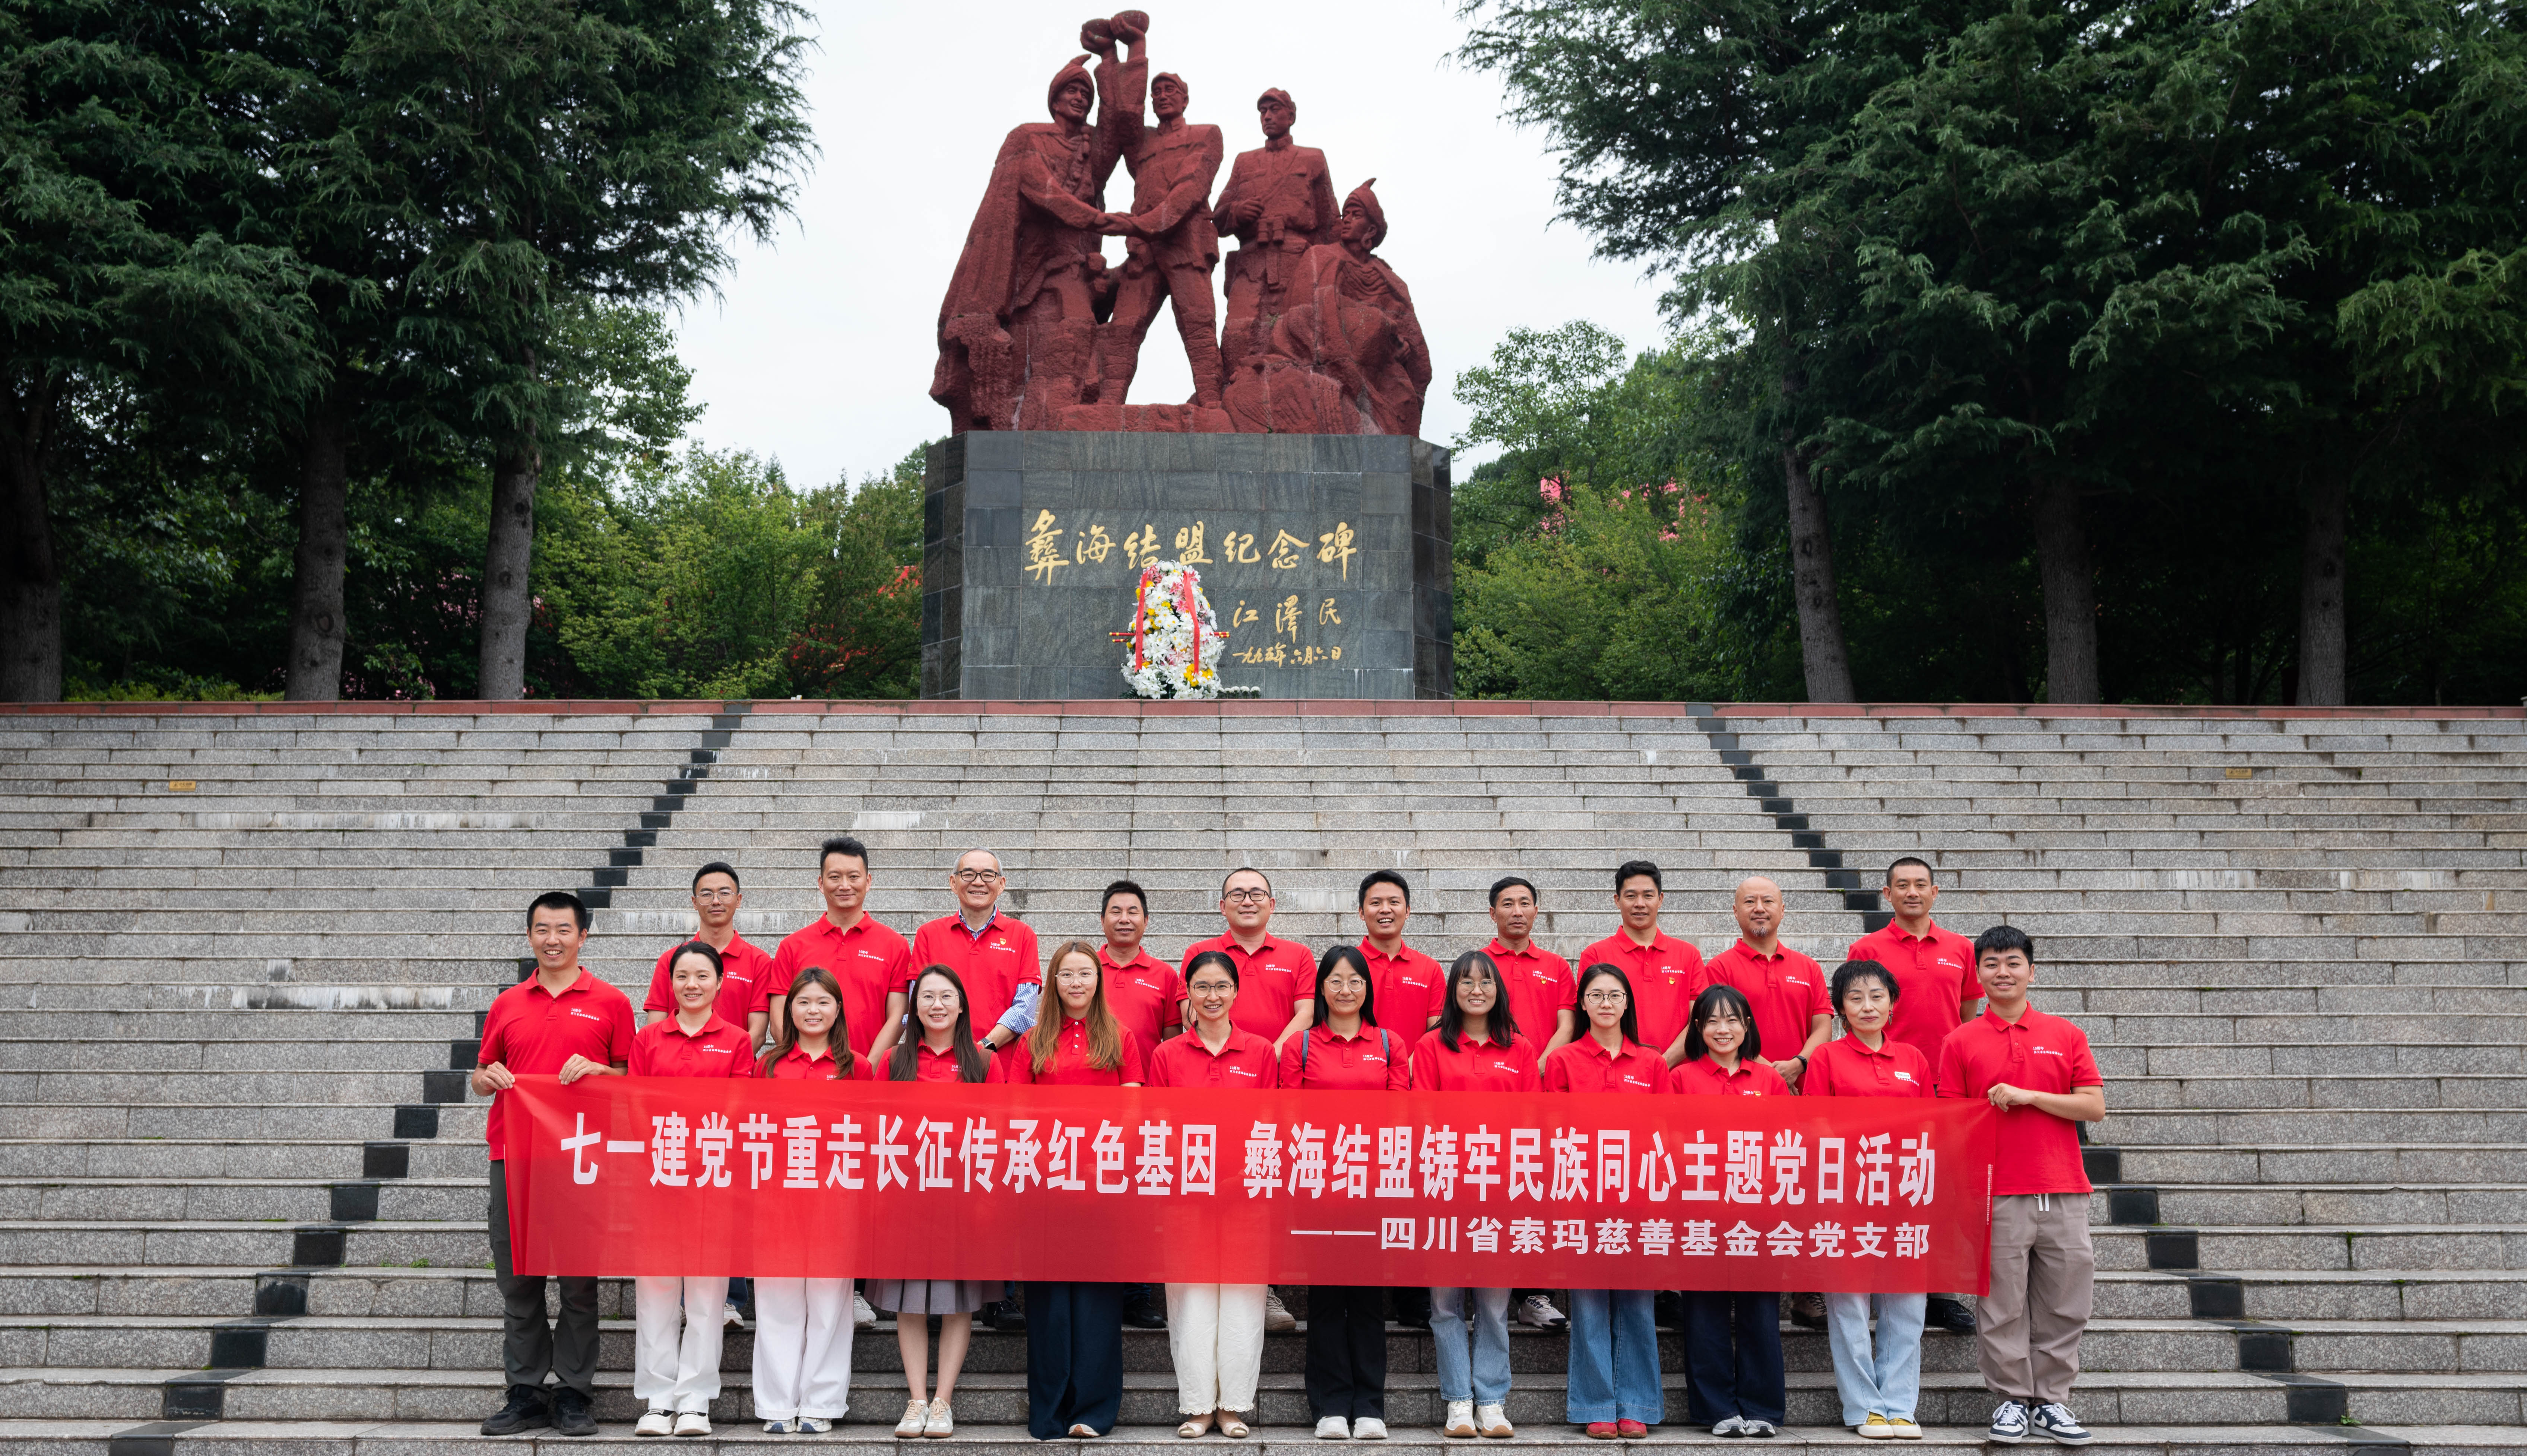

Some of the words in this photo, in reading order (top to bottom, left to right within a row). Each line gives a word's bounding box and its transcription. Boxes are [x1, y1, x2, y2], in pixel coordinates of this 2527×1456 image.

[1024, 509, 1357, 585] 彝海结盟纪念碑
[561, 1112, 1217, 1196] 七一建党节重走长征传承红色基因
[1243, 1120, 1935, 1207] 彝海结盟铸牢民族同心主题党日活动
